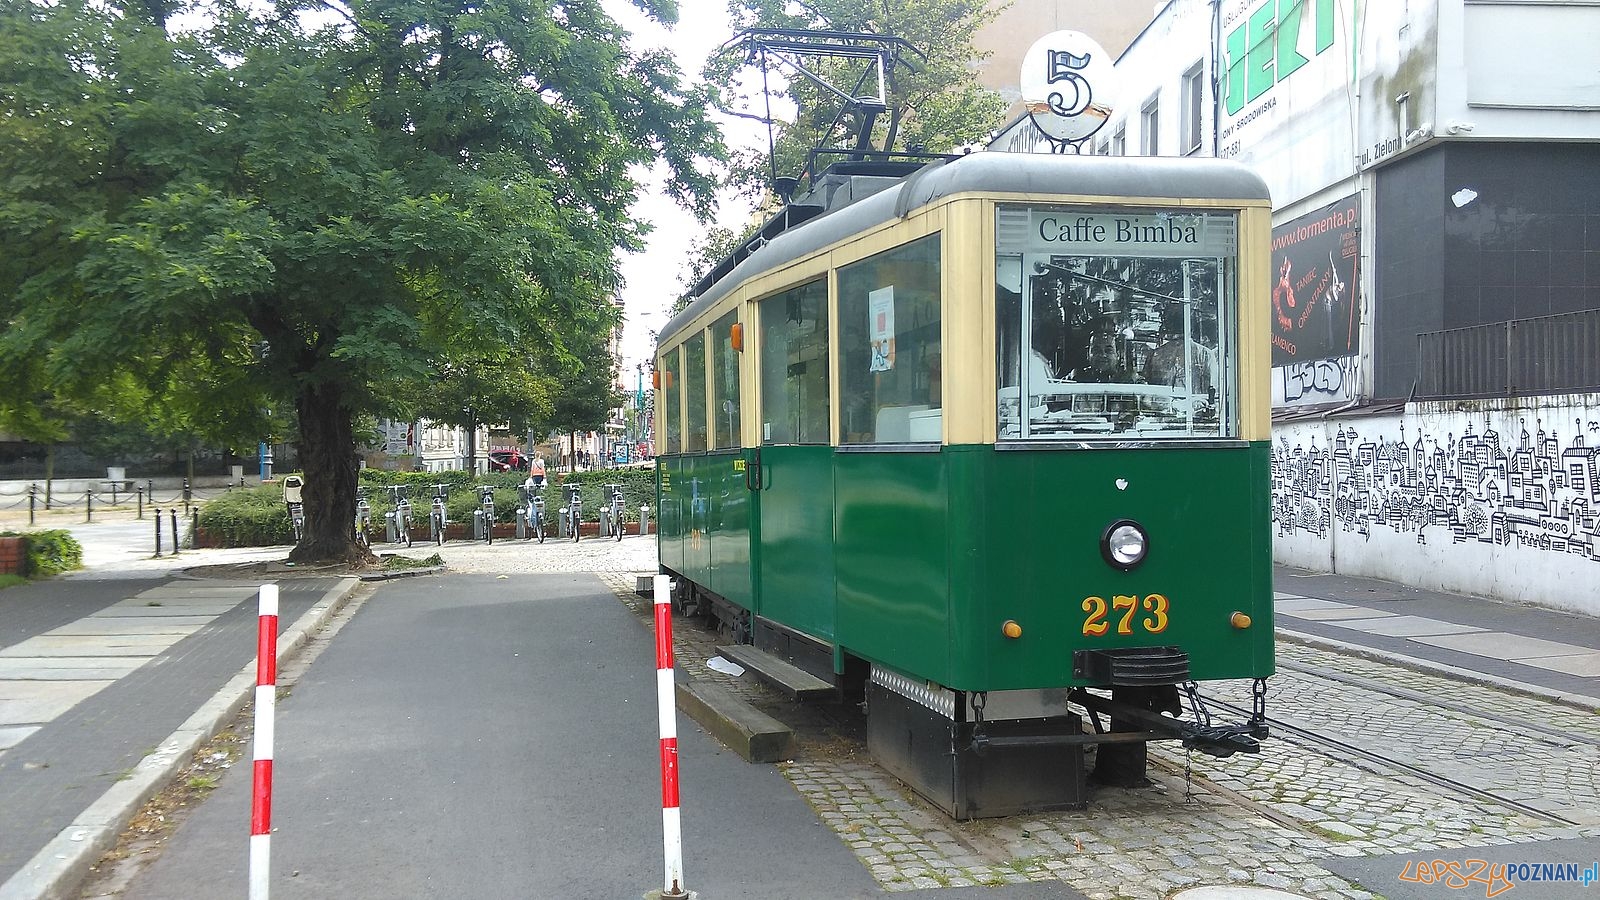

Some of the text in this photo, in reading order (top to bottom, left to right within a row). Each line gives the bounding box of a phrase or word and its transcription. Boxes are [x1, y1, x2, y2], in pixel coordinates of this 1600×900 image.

[1047, 49, 1092, 118] 5
[1361, 148, 1372, 166] ul.
[1039, 217, 1198, 244] Caffe Bimba
[1296, 266, 1317, 292] TANIEC
[1298, 267, 1331, 329] ORIENTALNY
[1081, 593, 1170, 637] 273
